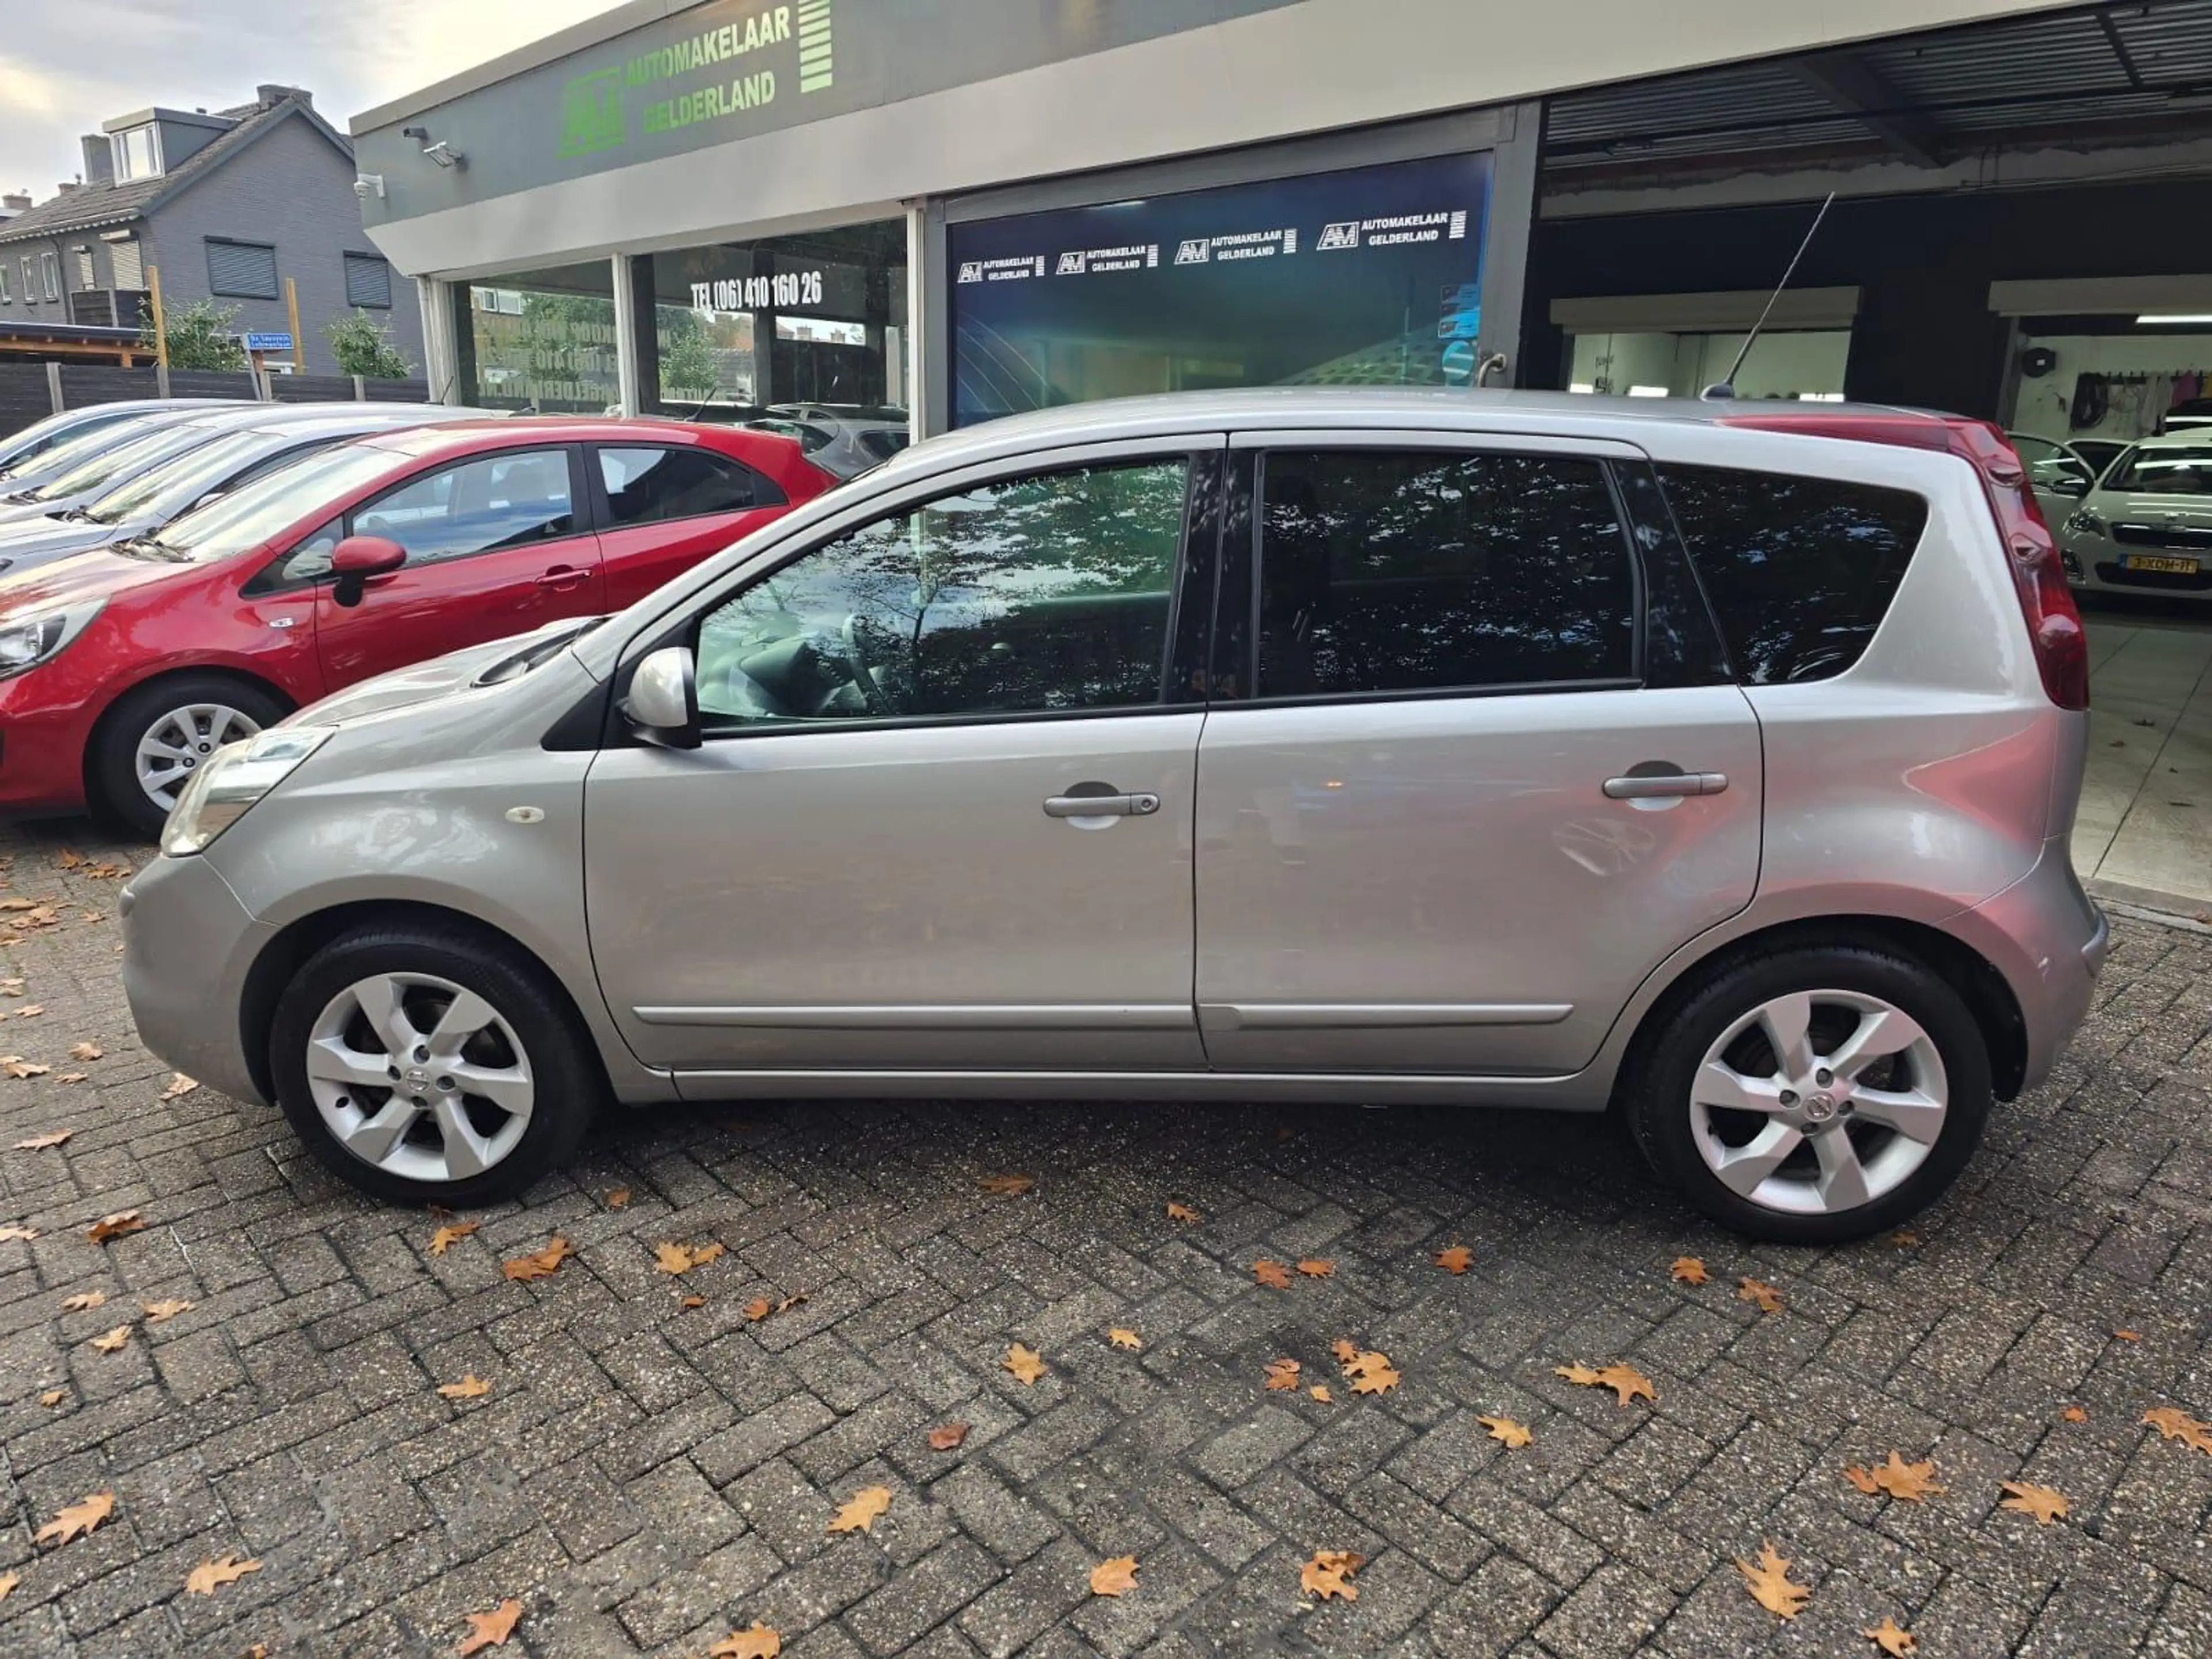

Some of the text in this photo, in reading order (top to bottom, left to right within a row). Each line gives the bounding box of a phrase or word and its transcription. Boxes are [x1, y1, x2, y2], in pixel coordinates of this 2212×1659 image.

[625, 6, 791, 88] AUTOMAKELAAR
[643, 71, 776, 134] GELDERLAND
[1361, 213, 1448, 232] AUTOMAKELAAR
[1211, 230, 1282, 248] AUTOMAKELAAR
[1368, 230, 1440, 247] GELDERLAND
[1086, 245, 1146, 259] AUTOMAKELAAR
[1217, 246, 1275, 261] GELDERLAND
[1092, 259, 1141, 272] GELDERLAND
[690, 270, 823, 312] TEL (06) 410 160 26
